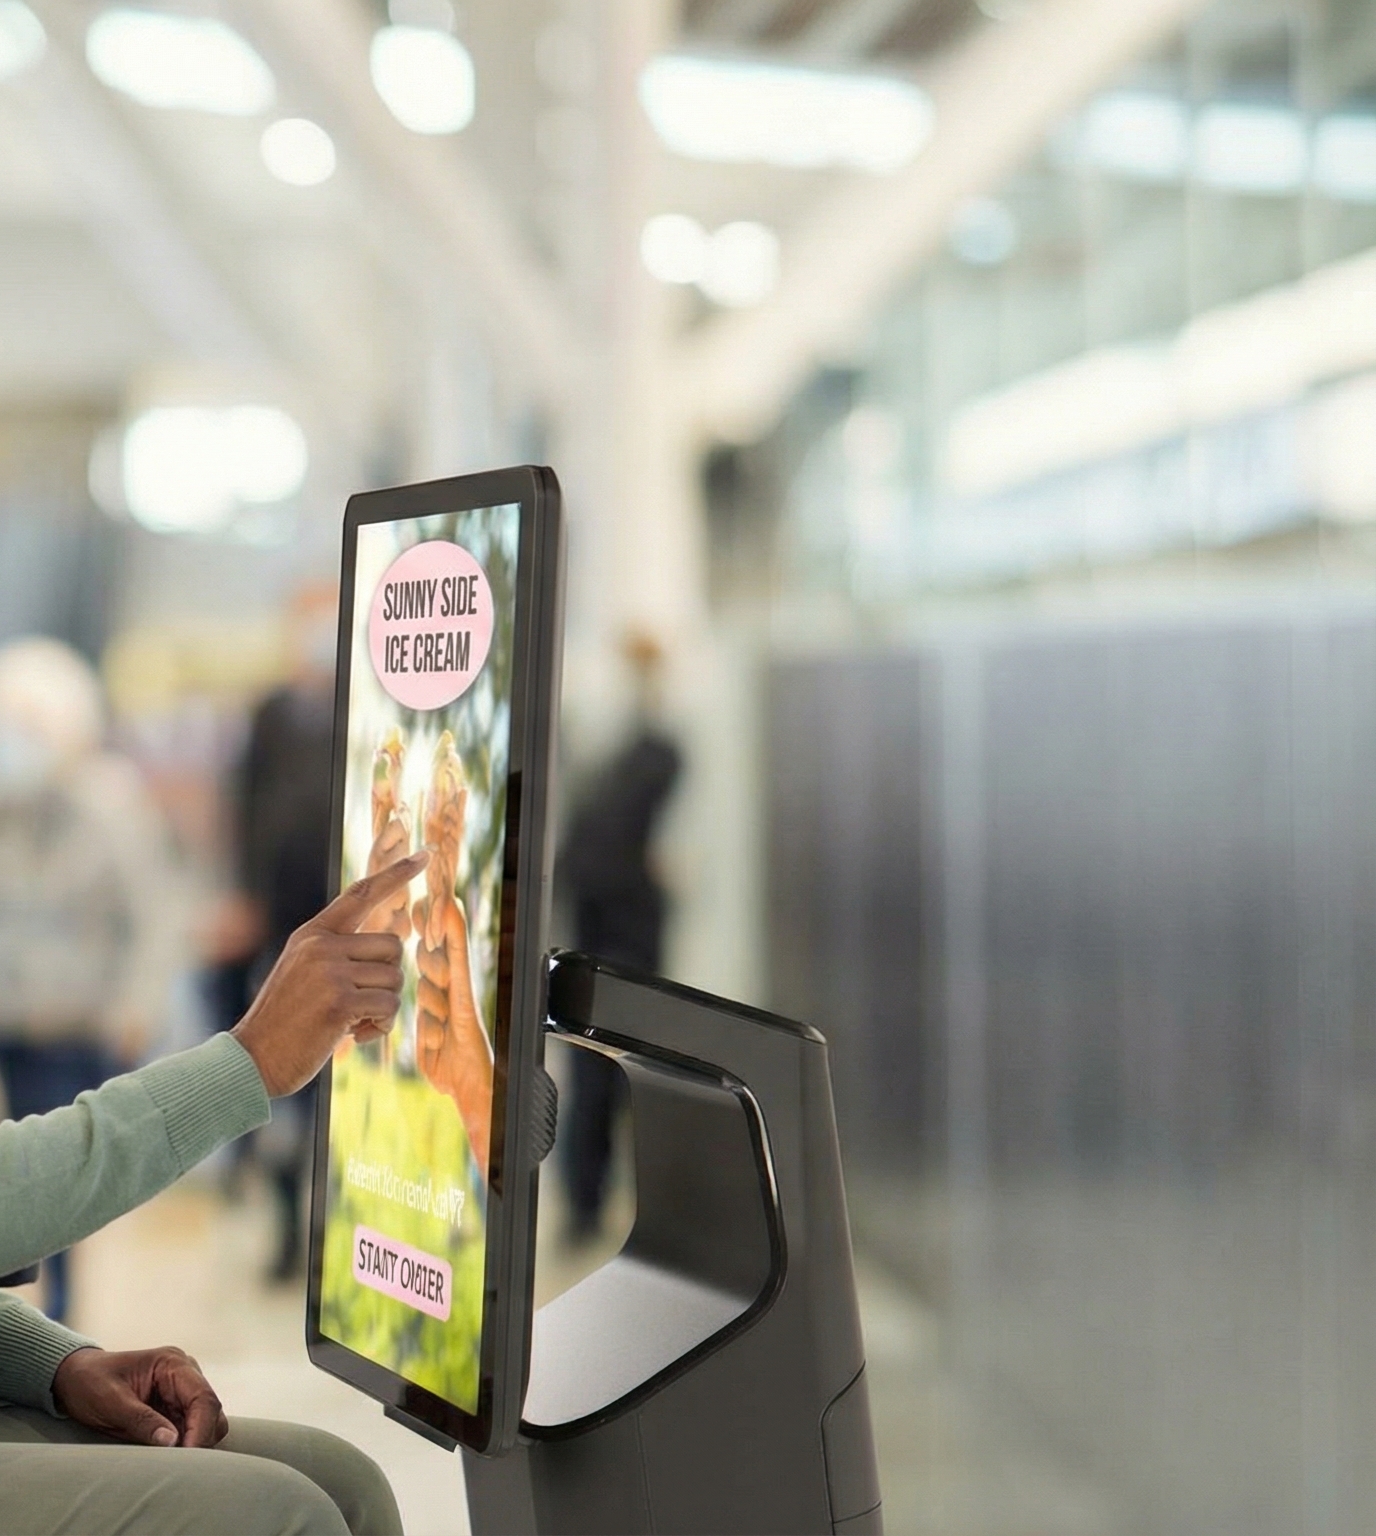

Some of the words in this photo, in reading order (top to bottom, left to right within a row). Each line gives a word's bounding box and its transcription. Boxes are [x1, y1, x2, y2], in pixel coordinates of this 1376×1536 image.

[383, 578, 438, 621] SUNNY
[440, 575, 478, 618] SIDE
[384, 634, 410, 674] ICE
[413, 631, 471, 673] CREAM
